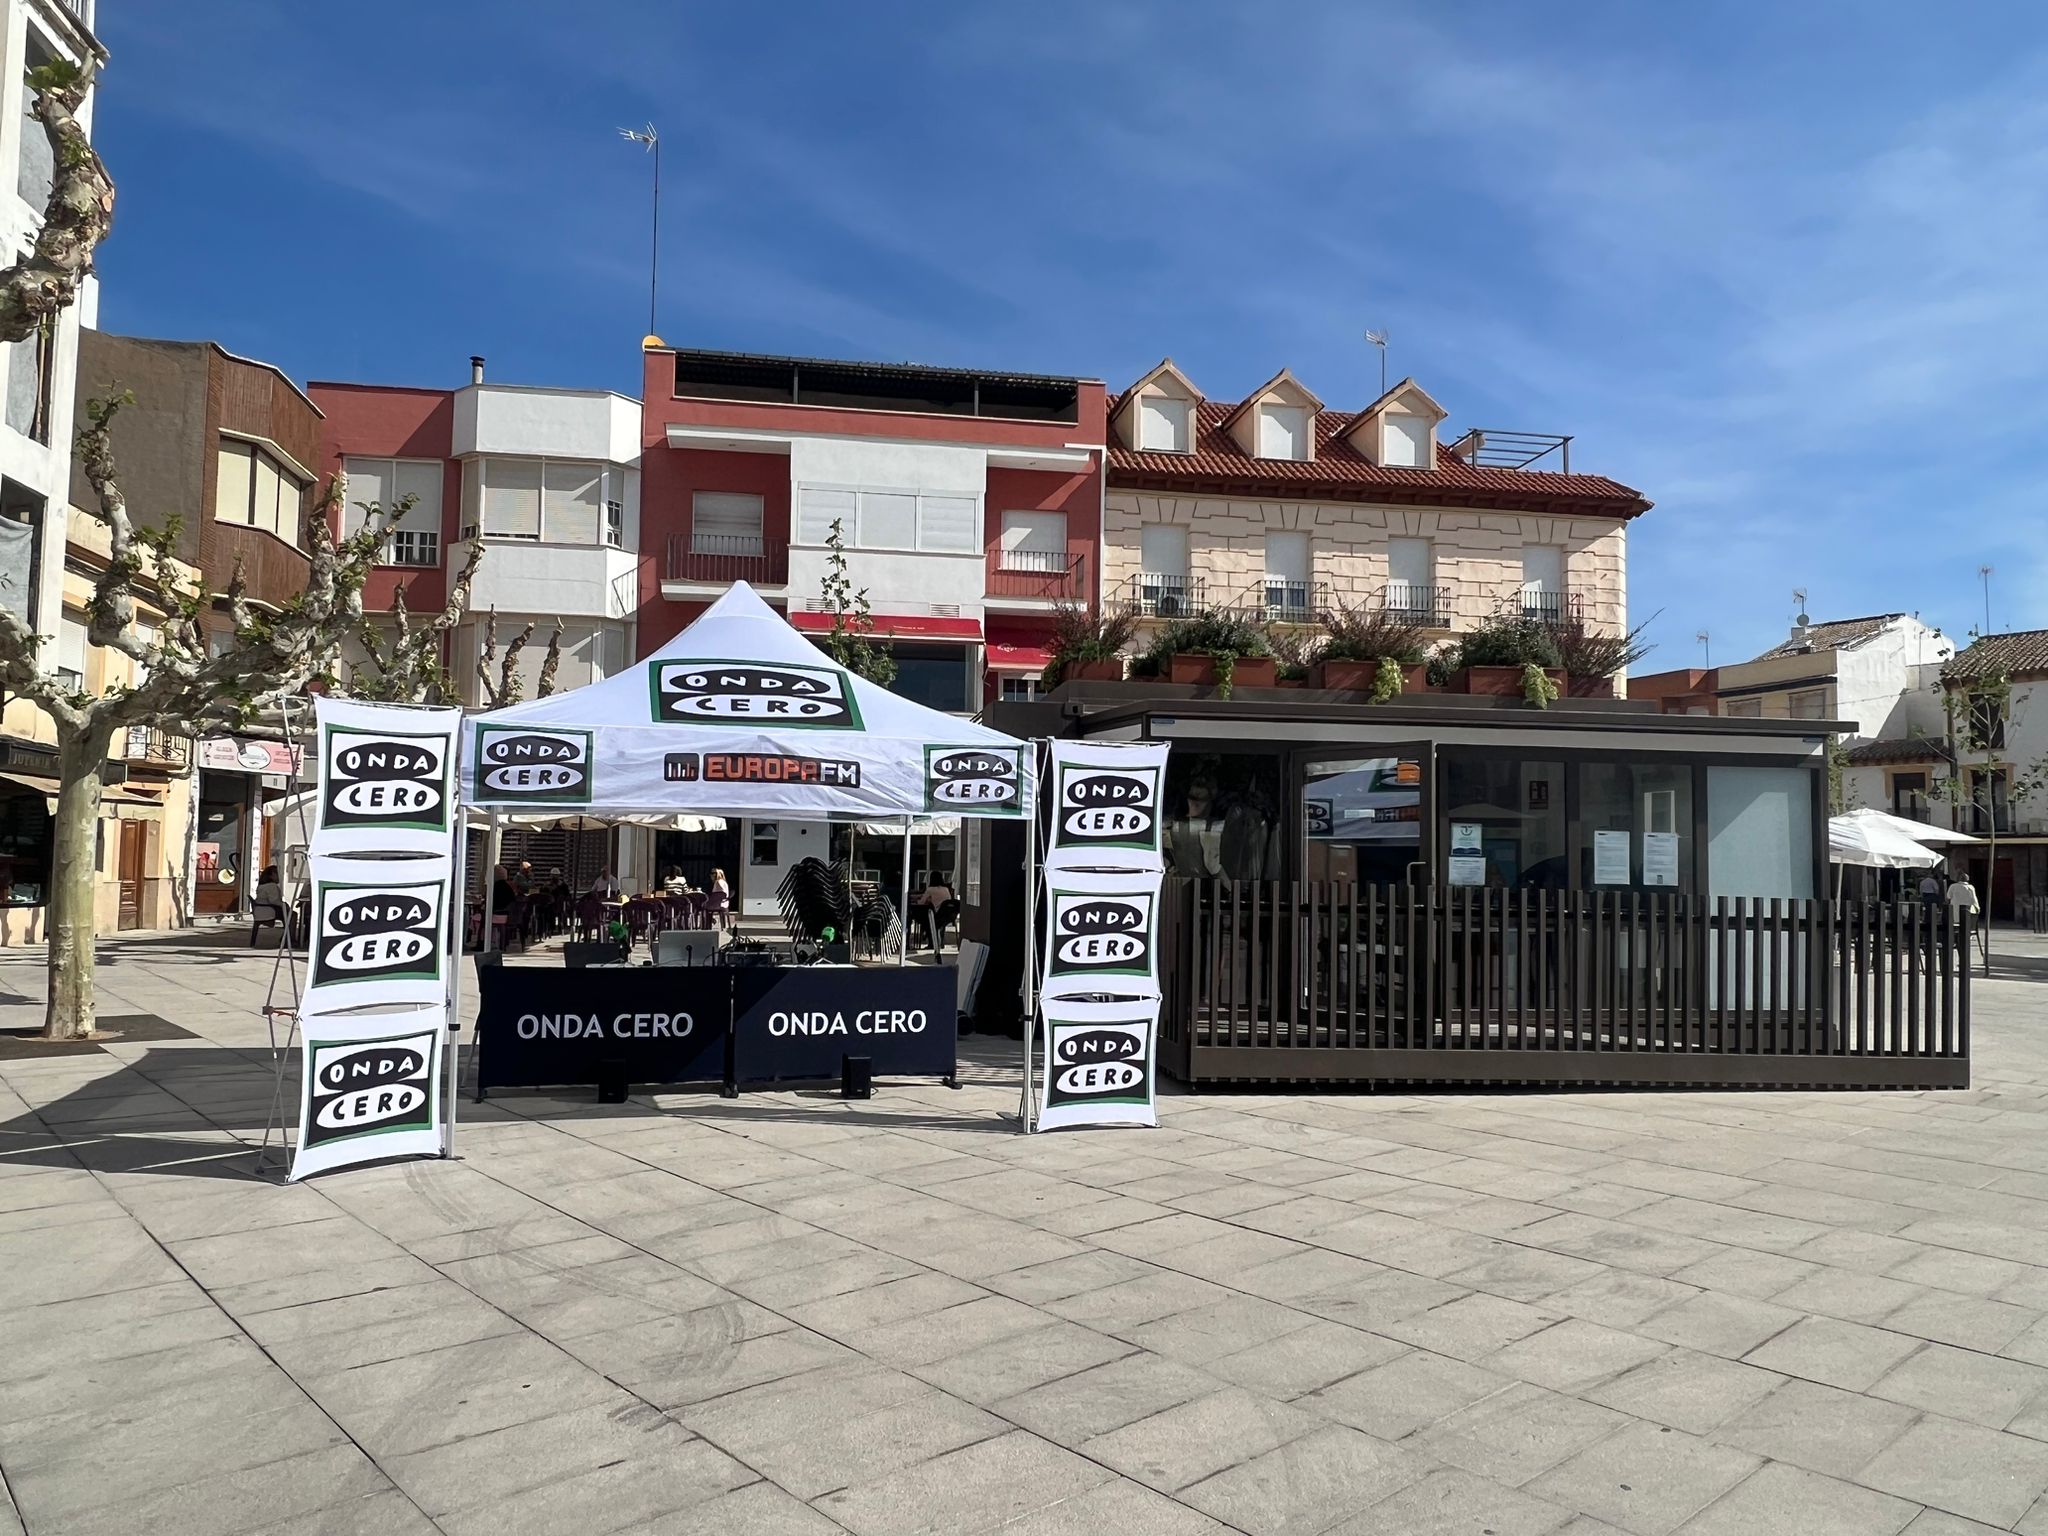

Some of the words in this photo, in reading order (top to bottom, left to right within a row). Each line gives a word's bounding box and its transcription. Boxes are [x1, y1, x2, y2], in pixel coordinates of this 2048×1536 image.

[685, 675, 816, 692] ONDA
[696, 698, 821, 714] CERO
[495, 743, 571, 758] ONDA
[345, 751, 429, 770] ONDA
[941, 759, 1005, 773] ONDA
[498, 769, 571, 785] CERO
[348, 786, 428, 807] CERO
[945, 783, 1005, 798] CERO
[1074, 783, 1142, 799] ONDA
[1077, 813, 1141, 830] CERO
[338, 904, 423, 925] ONDA
[1068, 910, 1136, 926] ONDA
[340, 939, 421, 962] CERO
[1070, 940, 1135, 957] CERO
[517, 1013, 604, 1039] ONDA
[613, 1012, 694, 1038] CERO
[768, 1011, 849, 1037] ONDA
[855, 1009, 928, 1034] CERO
[1065, 1039, 1134, 1056] ONDA
[329, 1056, 415, 1083] ONDA
[1068, 1069, 1133, 1087] CERO
[332, 1090, 413, 1121] CERO
